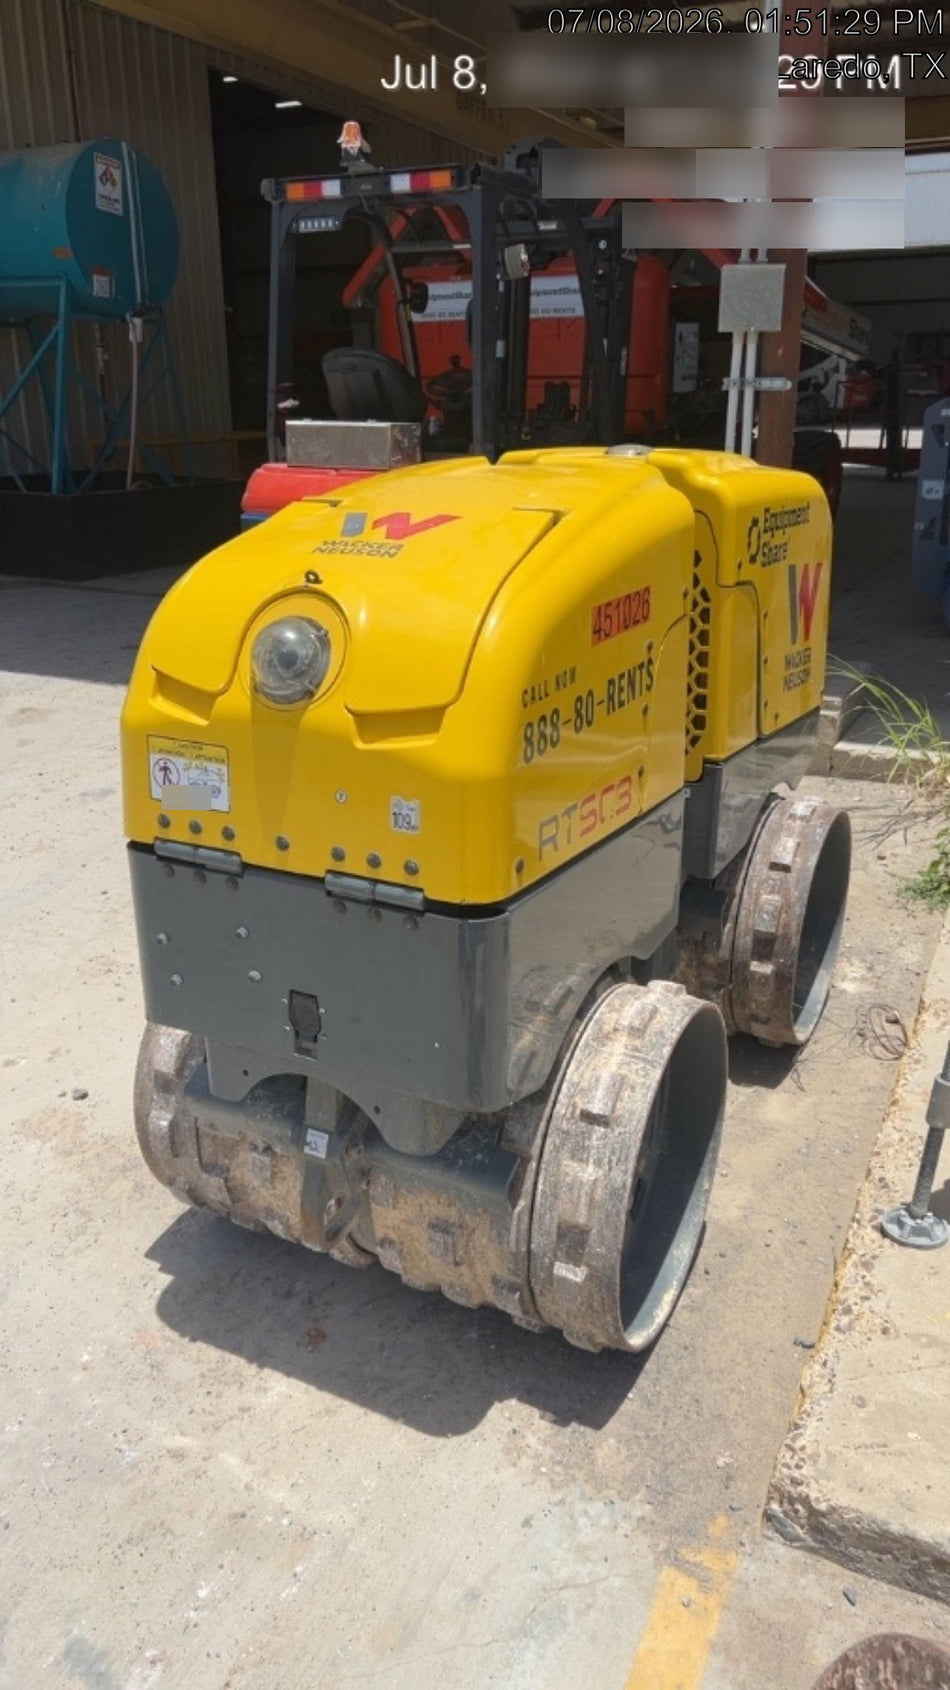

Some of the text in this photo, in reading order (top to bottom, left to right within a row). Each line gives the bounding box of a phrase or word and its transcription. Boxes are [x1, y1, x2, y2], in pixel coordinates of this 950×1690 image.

[763, 501, 810, 538] Equipment
[312, 547, 399, 558] NEUSON
[322, 540, 404, 550] WACKER
[761, 541, 788, 568] Share
[592, 586, 650, 641] 451026
[784, 647, 812, 671] WACKER
[521, 666, 577, 708] CALL NOW
[523, 656, 655, 765] 888-80-RENTS
